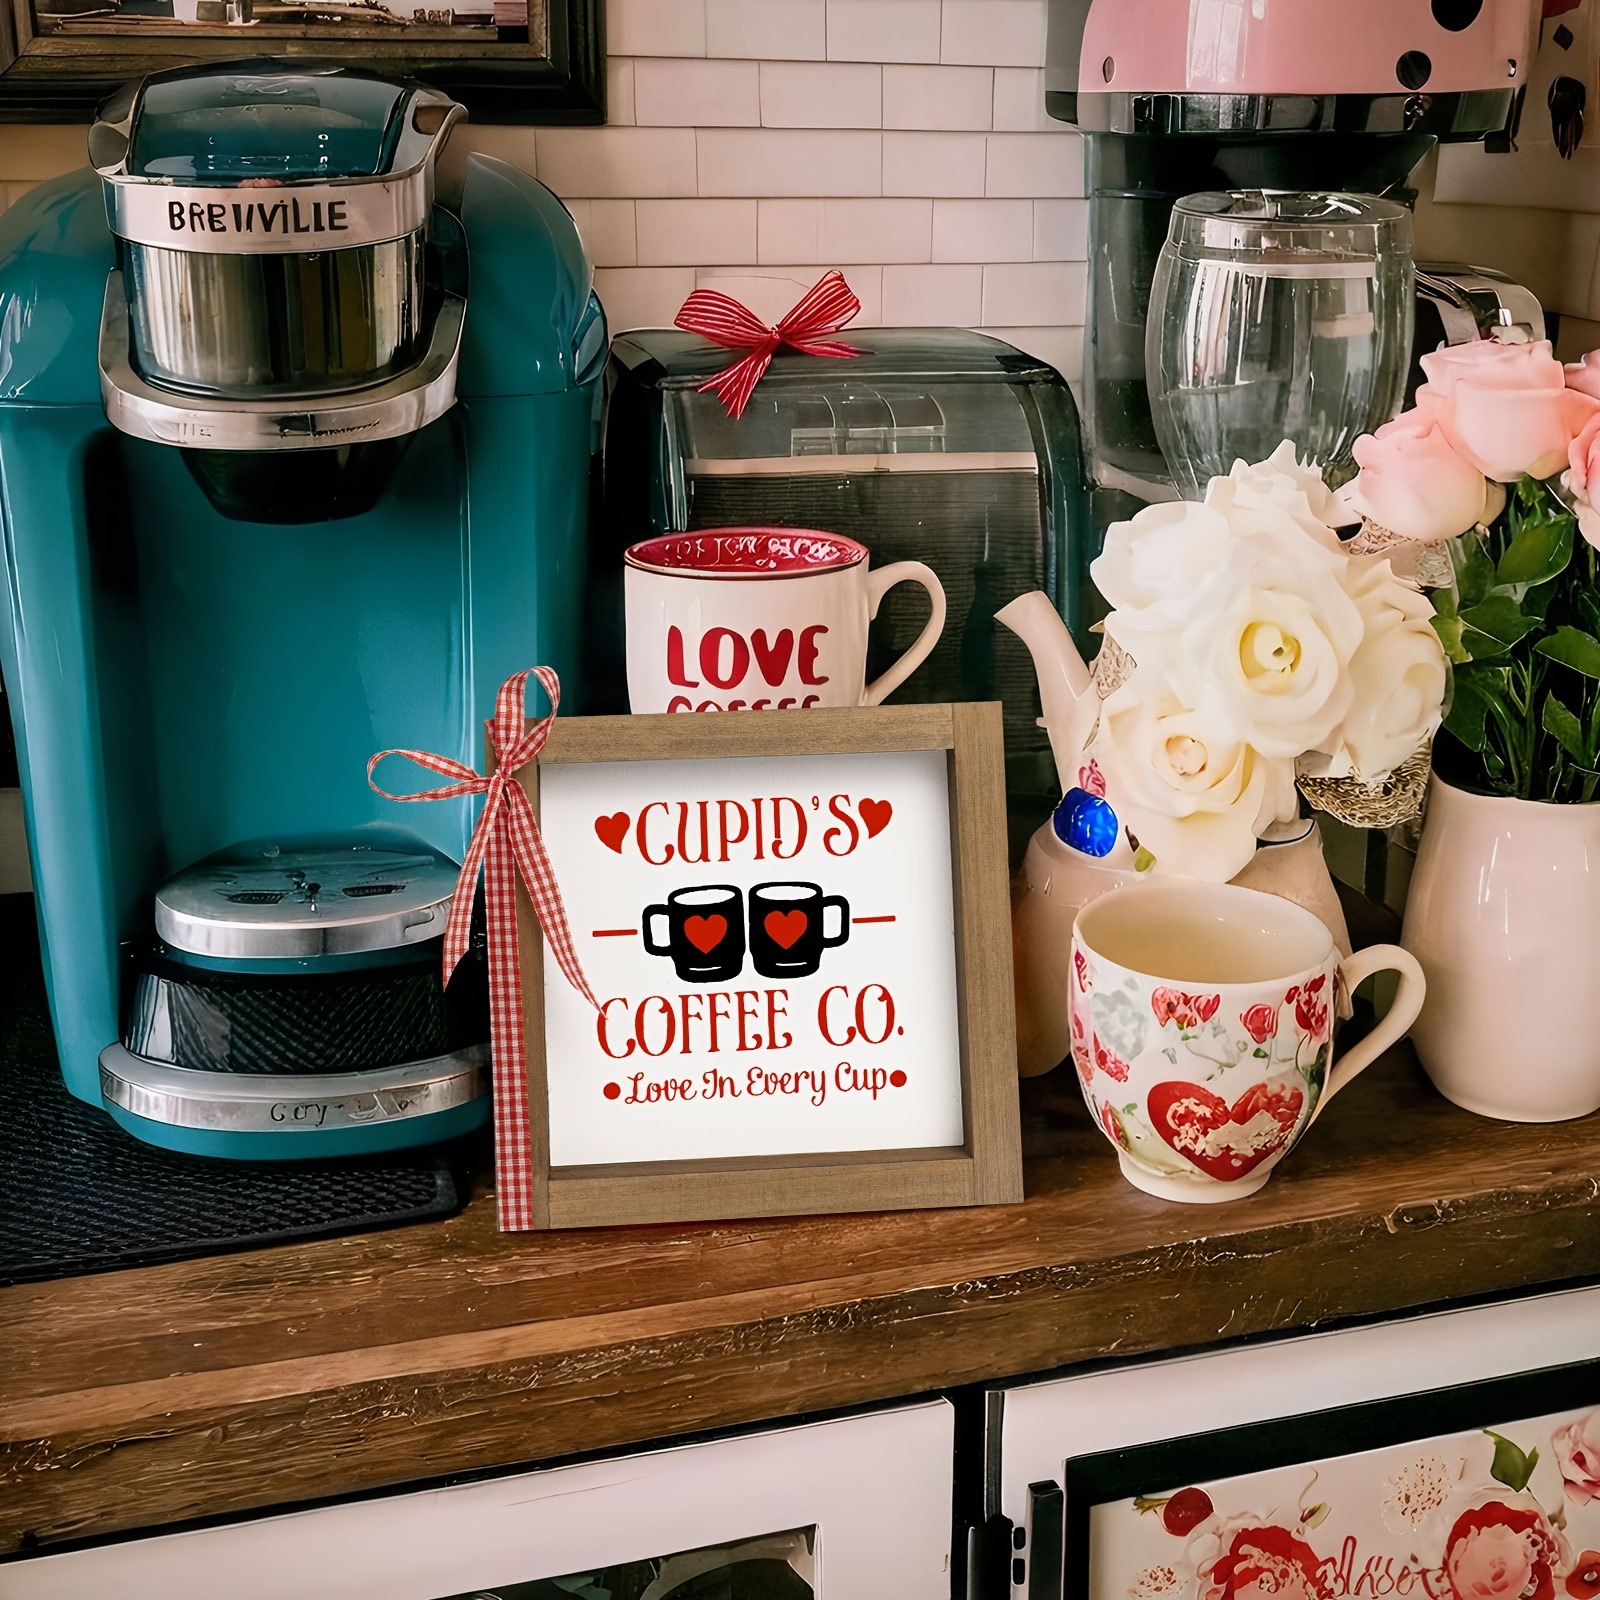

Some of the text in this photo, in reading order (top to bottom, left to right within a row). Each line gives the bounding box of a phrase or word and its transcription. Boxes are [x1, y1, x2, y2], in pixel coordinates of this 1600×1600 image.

[666, 623, 830, 690] LOVE
[635, 793, 860, 866] CUPID'S
[596, 983, 905, 1059] COFFEE CO.
[624, 1061, 888, 1107] Love In Every Cup
